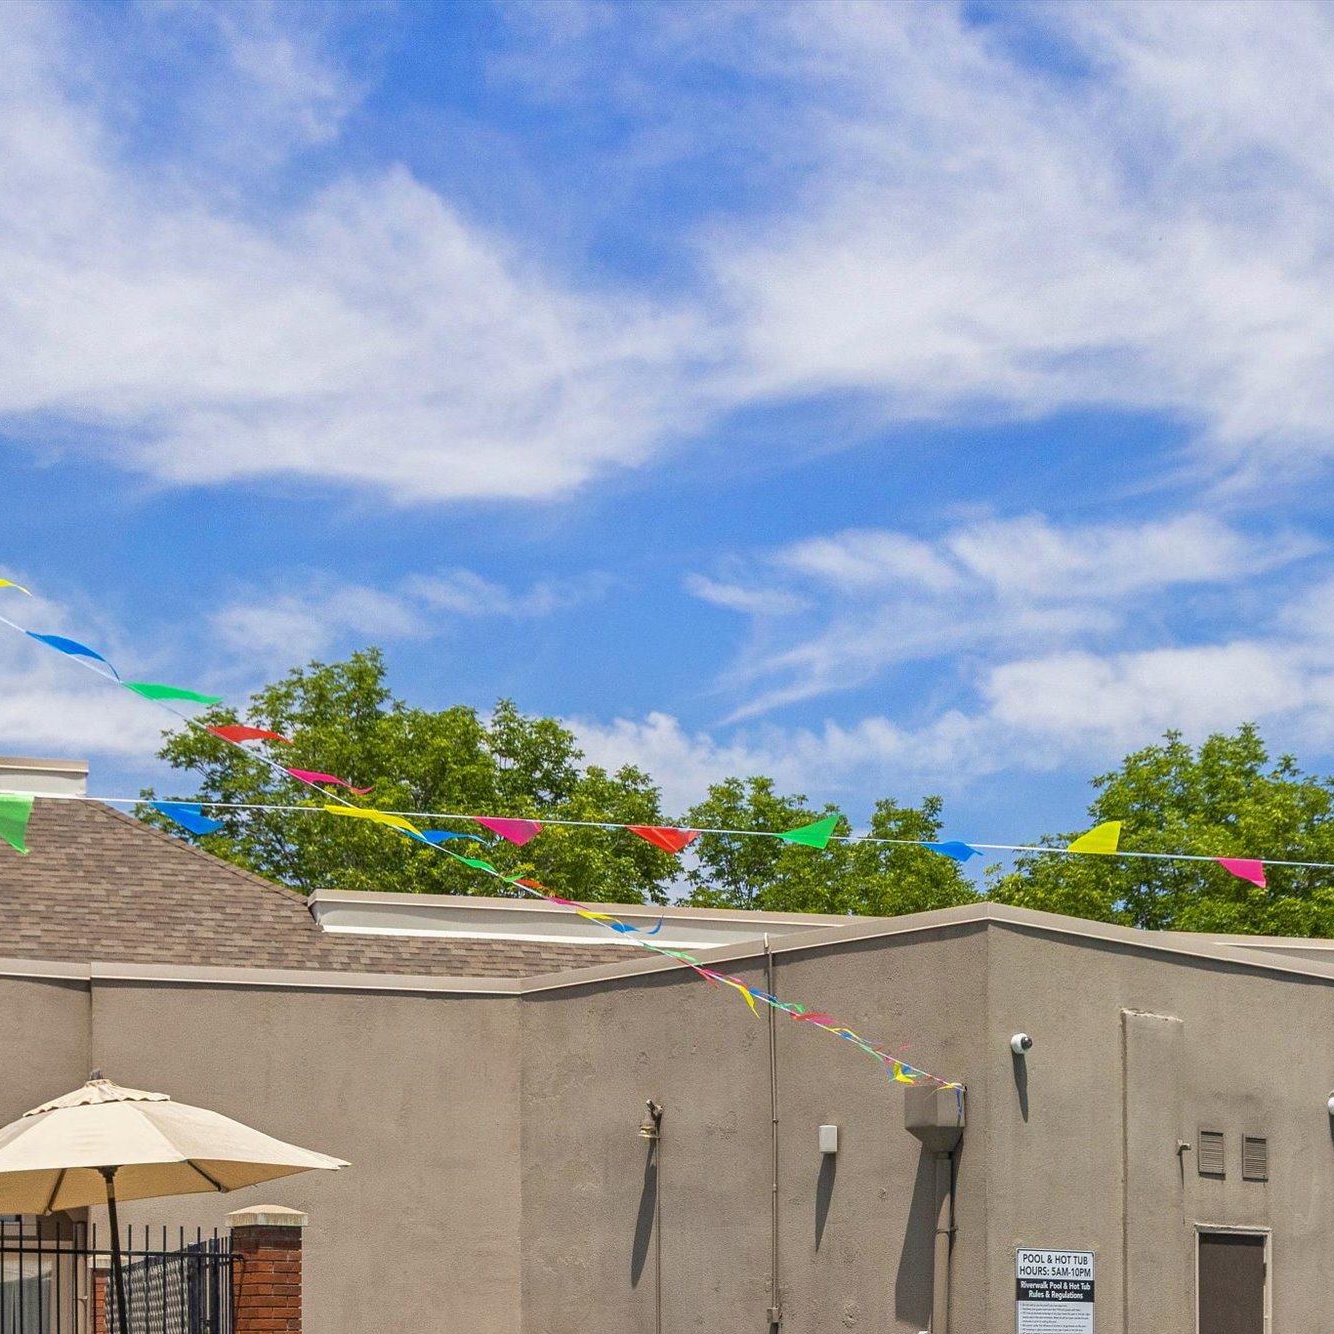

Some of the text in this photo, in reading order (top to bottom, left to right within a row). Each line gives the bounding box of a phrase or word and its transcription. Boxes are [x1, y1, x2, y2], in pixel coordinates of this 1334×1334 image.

[1022, 1253, 1088, 1265] POOL & HOT TUB
[1019, 1265, 1091, 1277] HOURS: 5AM-10PM
[1020, 1280, 1049, 1289] Riverwalk
[1049, 1281, 1062, 1289] Pool
[1069, 1282, 1080, 1290] Hot
[1080, 1282, 1091, 1290] Tub
[1028, 1289, 1083, 1300] Rules & Regulations
